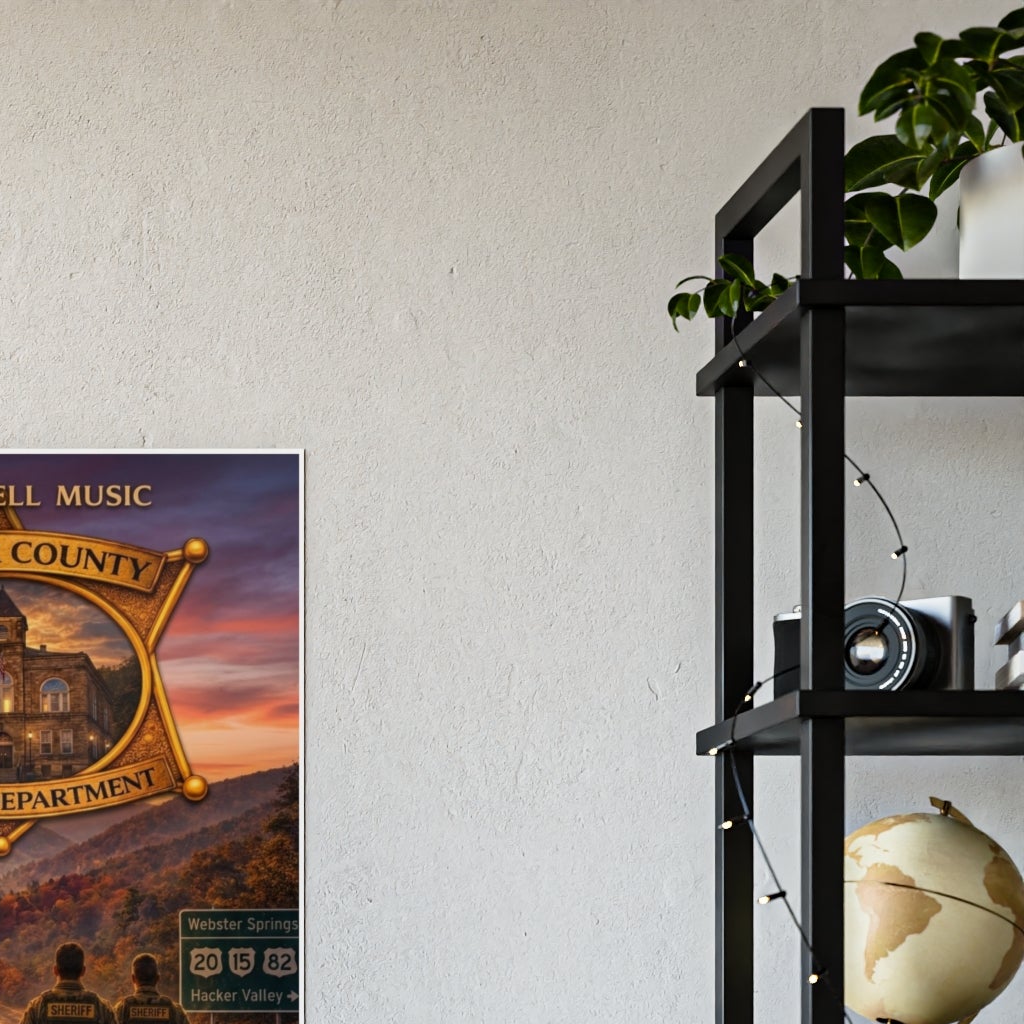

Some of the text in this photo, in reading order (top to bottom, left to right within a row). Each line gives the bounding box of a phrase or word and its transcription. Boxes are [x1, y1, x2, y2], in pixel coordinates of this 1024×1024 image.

[55, 484, 153, 507] MUSIC
[11, 541, 152, 582] COUNTY
[188, 917, 299, 934] Webster Springs
[194, 953, 292, 971] 20 15 82
[191, 988, 284, 1005] Hacker Valley
[50, 1004, 93, 1016] SHERIFF
[131, 1007, 168, 1017] SHERIFF
